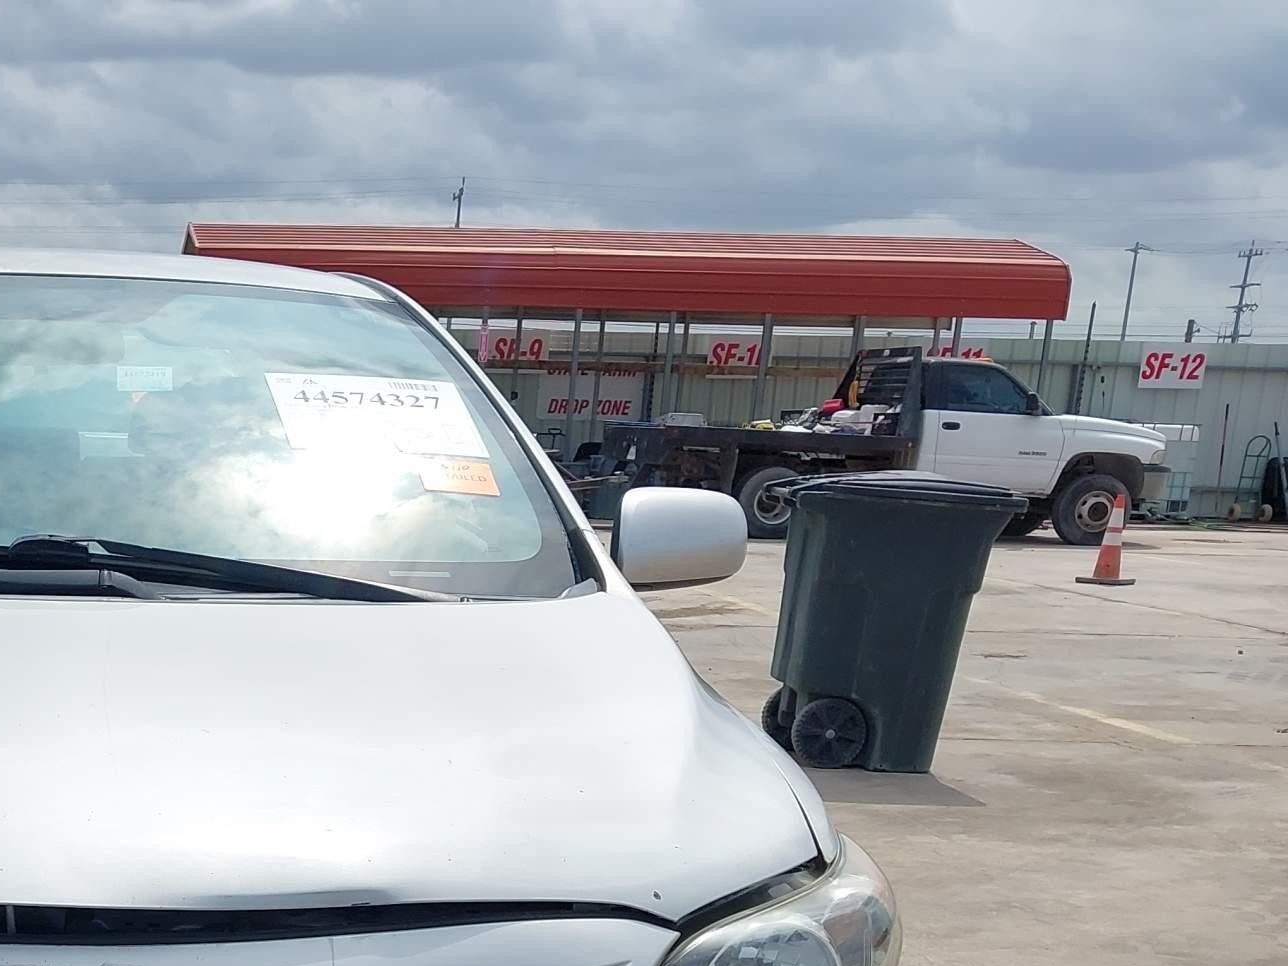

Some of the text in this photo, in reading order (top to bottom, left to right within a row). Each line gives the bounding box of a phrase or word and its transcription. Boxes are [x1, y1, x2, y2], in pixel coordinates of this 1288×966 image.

[709, 342, 761, 367] SF-1
[1141, 352, 1206, 380] SF-12
[293, 389, 440, 410] 44574327
